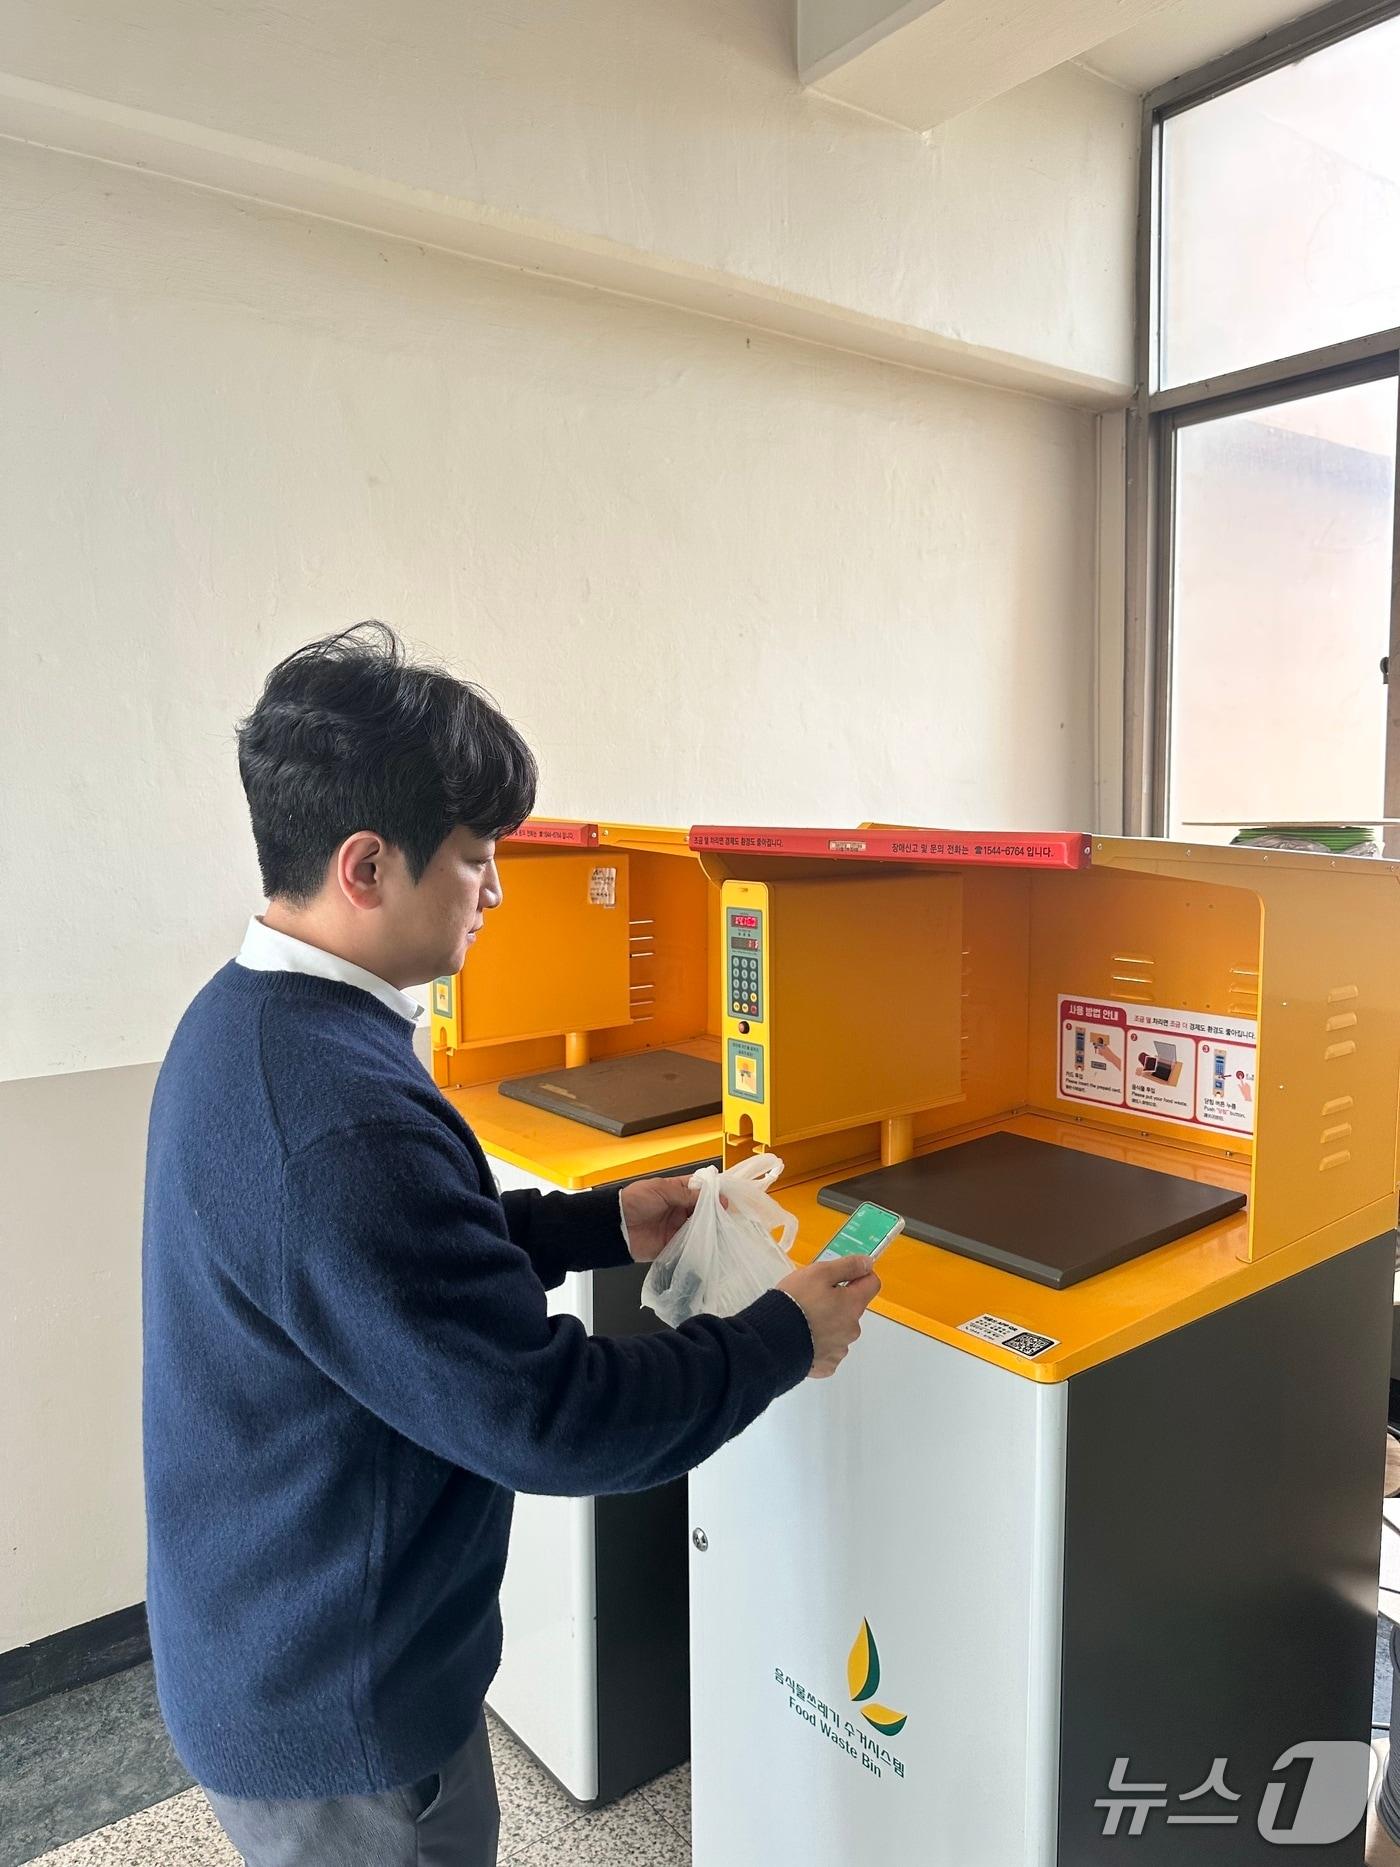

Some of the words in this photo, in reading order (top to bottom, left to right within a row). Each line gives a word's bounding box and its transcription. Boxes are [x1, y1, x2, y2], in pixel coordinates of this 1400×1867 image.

[892, 843, 919, 853] 장애신고
[921, 844, 928, 854] 및
[930, 844, 944, 854] 문의
[947, 845, 969, 855] 전화는
[983, 846, 1025, 856] 1544-6764
[1027, 846, 1055, 858] 입니다.
[1068, 1004, 1084, 1016] 사용
[1085, 1007, 1101, 1019] 방법
[1102, 1009, 1119, 1021] 안내
[1189, 1023, 1206, 1032] 경제도
[1207, 1025, 1224, 1035] 환경도
[775, 1667, 840, 1729] 음식물쓰레기
[844, 1721, 905, 1779] 수거시스템
[789, 1696, 817, 1727] Food
[820, 1719, 858, 1759] Waste
[862, 1752, 882, 1778] Bin
